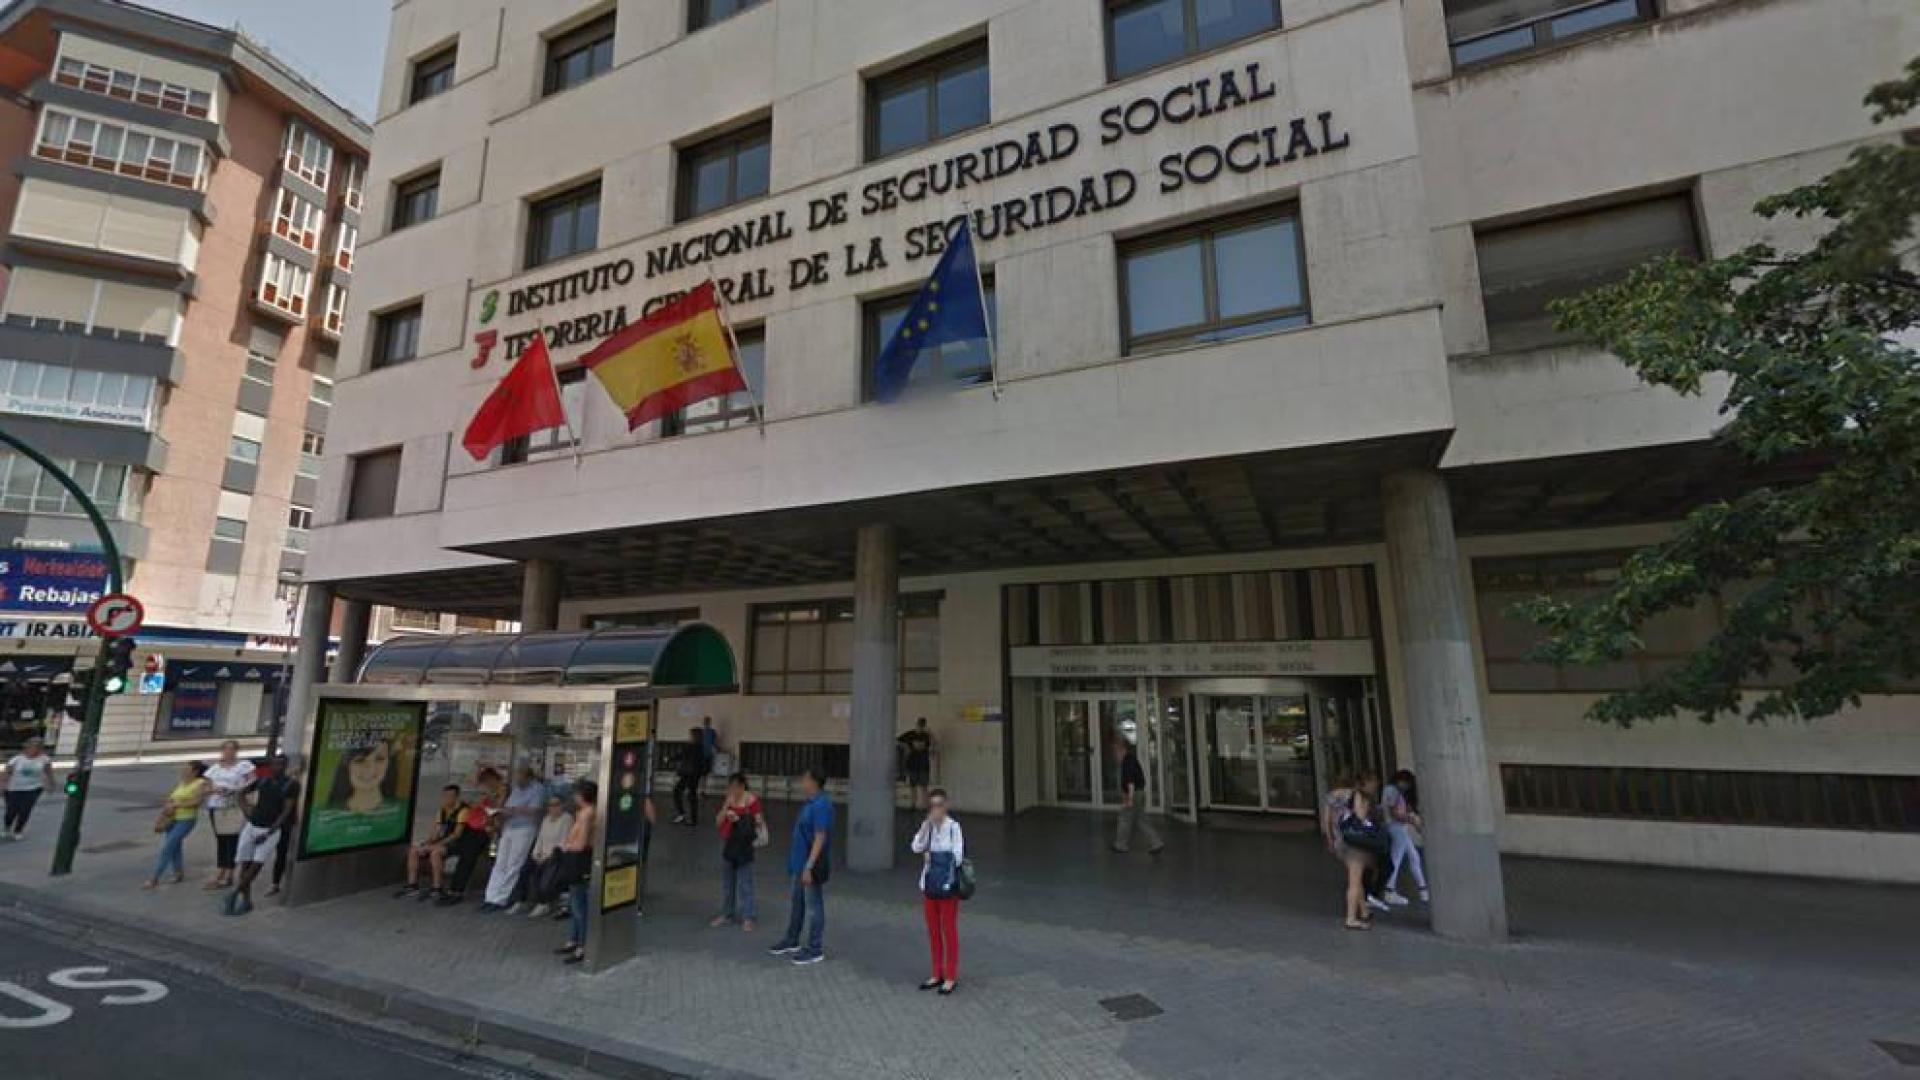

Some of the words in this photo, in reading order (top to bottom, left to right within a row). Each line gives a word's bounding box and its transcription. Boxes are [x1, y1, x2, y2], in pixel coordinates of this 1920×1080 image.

[503, 306, 628, 360] TEORERIA
[789, 252, 829, 291] DE
[844, 230, 889, 277] LA
[1159, 110, 1351, 195] SOCIAL
[508, 259, 634, 316] INSTITUTO
[645, 210, 793, 279] NACIONAL
[808, 197, 849, 232] DE
[861, 122, 1080, 212] SEGURIDAD
[1099, 61, 1276, 146] SOCIAL
[19, 585, 100, 607] Rebajas
[25, 621, 95, 638] IRABI
